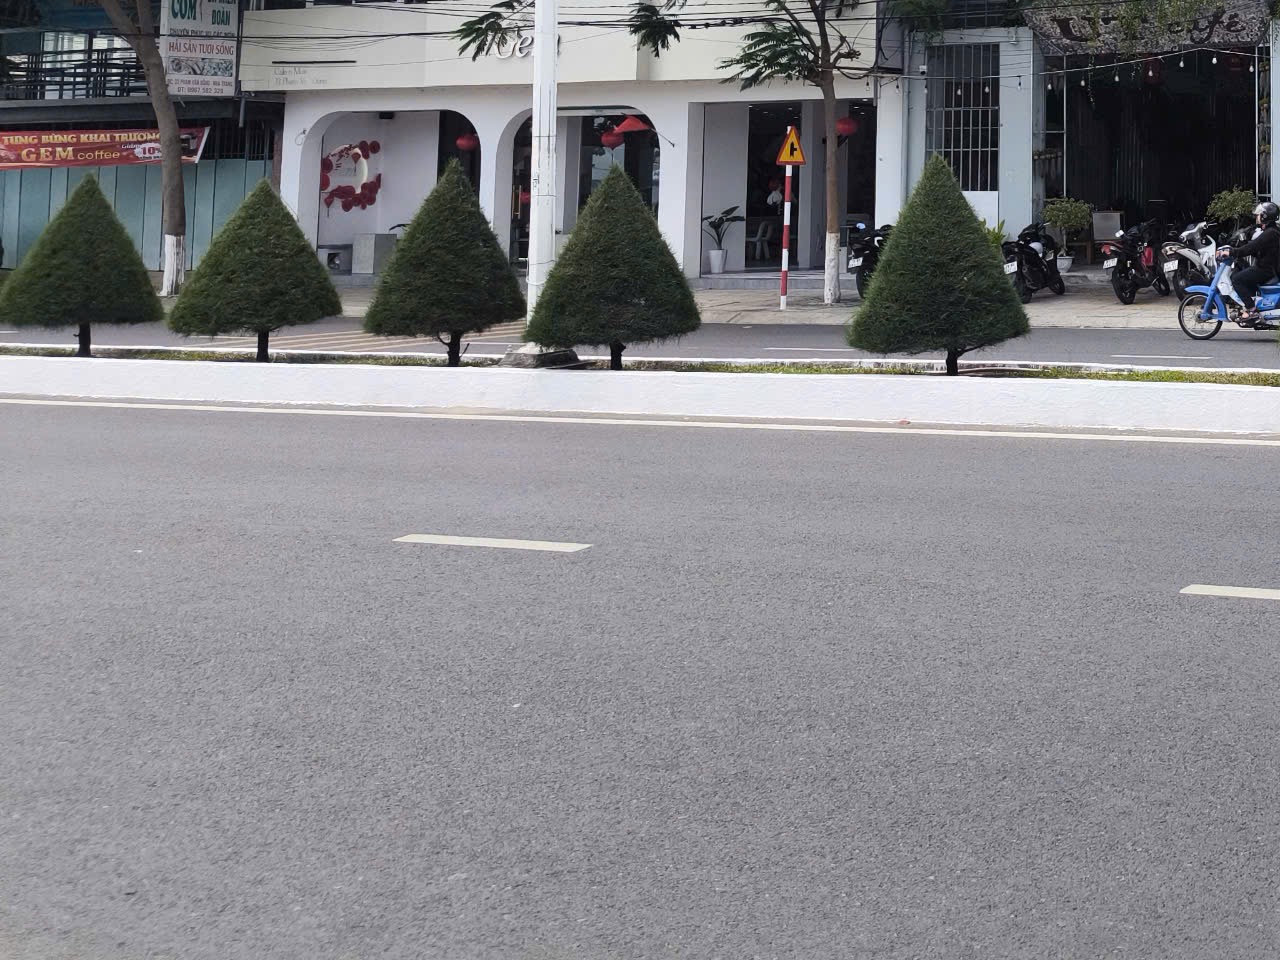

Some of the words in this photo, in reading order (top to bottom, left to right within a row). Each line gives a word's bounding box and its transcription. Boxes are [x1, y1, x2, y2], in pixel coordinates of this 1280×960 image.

[79, 133, 111, 143] KHAI
[21, 146, 75, 162] GEM
[77, 149, 121, 161] coffee
